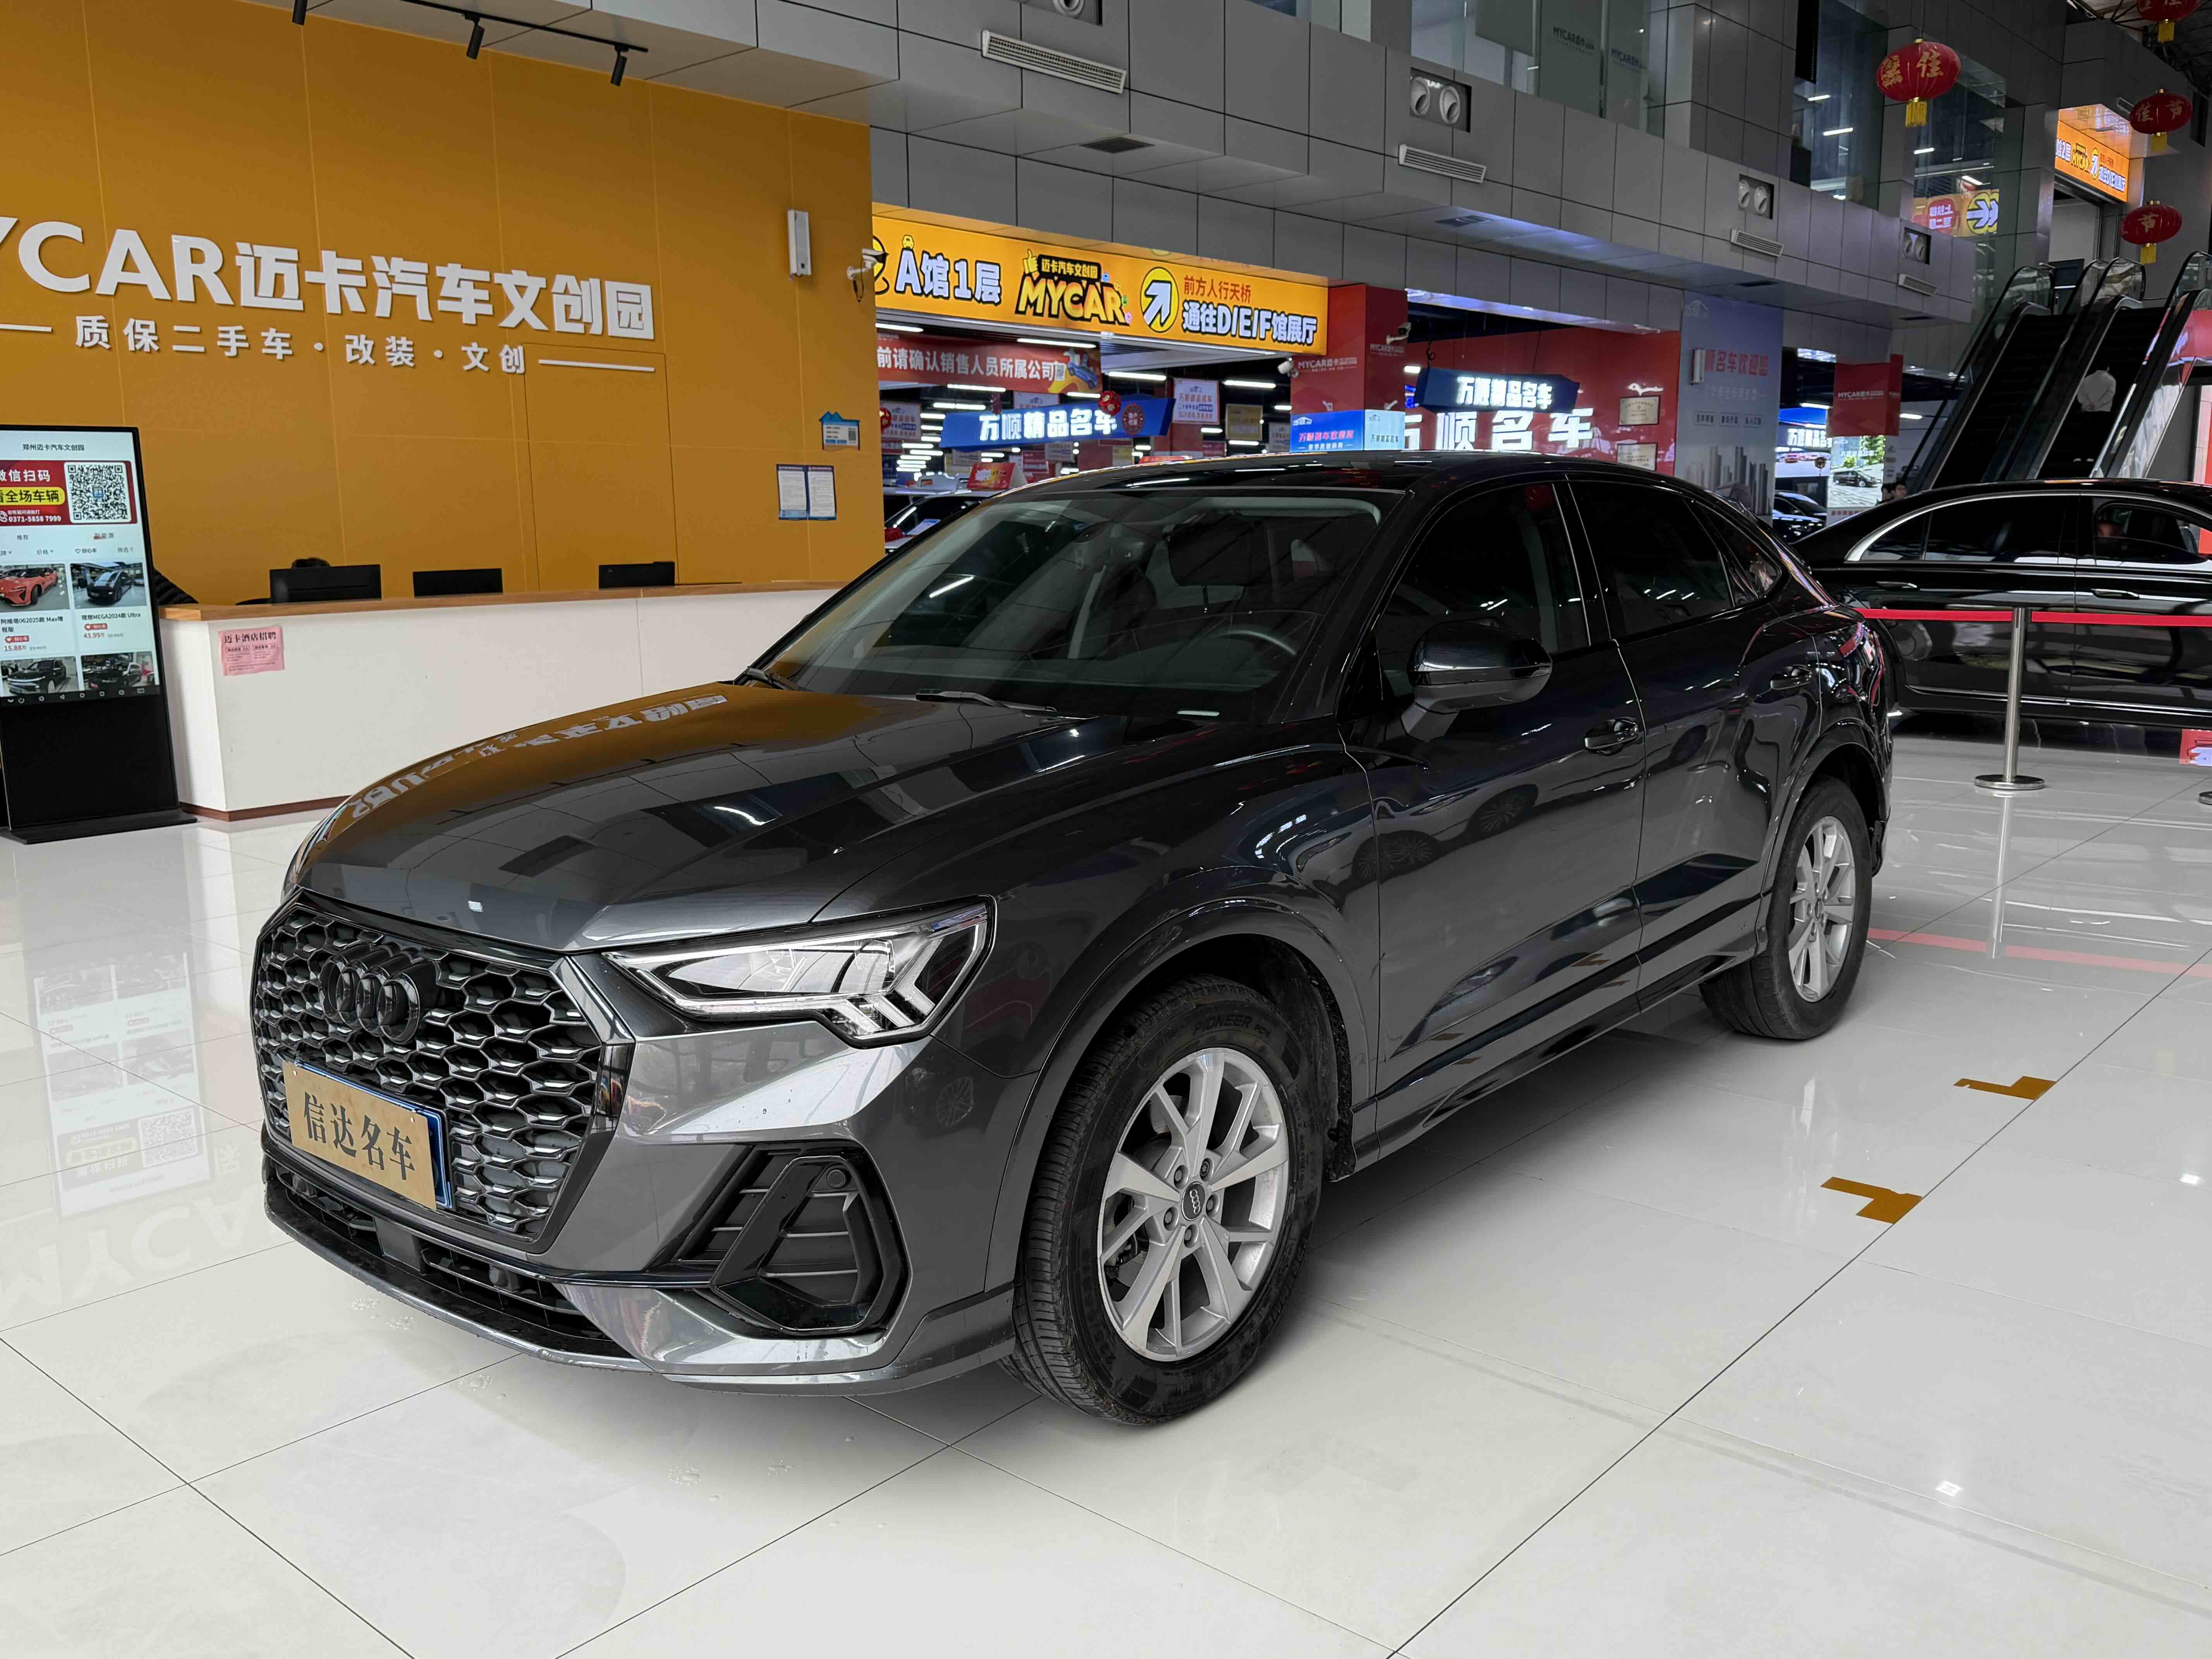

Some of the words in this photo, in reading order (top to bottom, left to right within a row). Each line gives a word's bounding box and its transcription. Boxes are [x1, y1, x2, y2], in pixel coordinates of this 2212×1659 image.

[0, 216, 654, 340] CAR迈卡汽车文创园
[895, 248, 1001, 305] A馆1层
[1041, 258, 1099, 280] 迈卡汽车文创园
[1183, 275, 1252, 304] 前方人行天桥
[1016, 276, 1127, 325] MYCAR
[1182, 301, 1317, 345] 通往D/E/F馆展厅
[978, 408, 1118, 441] 万顺精品名车
[22, 443, 85, 452] 郑州迈卡汽车文创园
[303, 1091, 416, 1181] 信达名车
